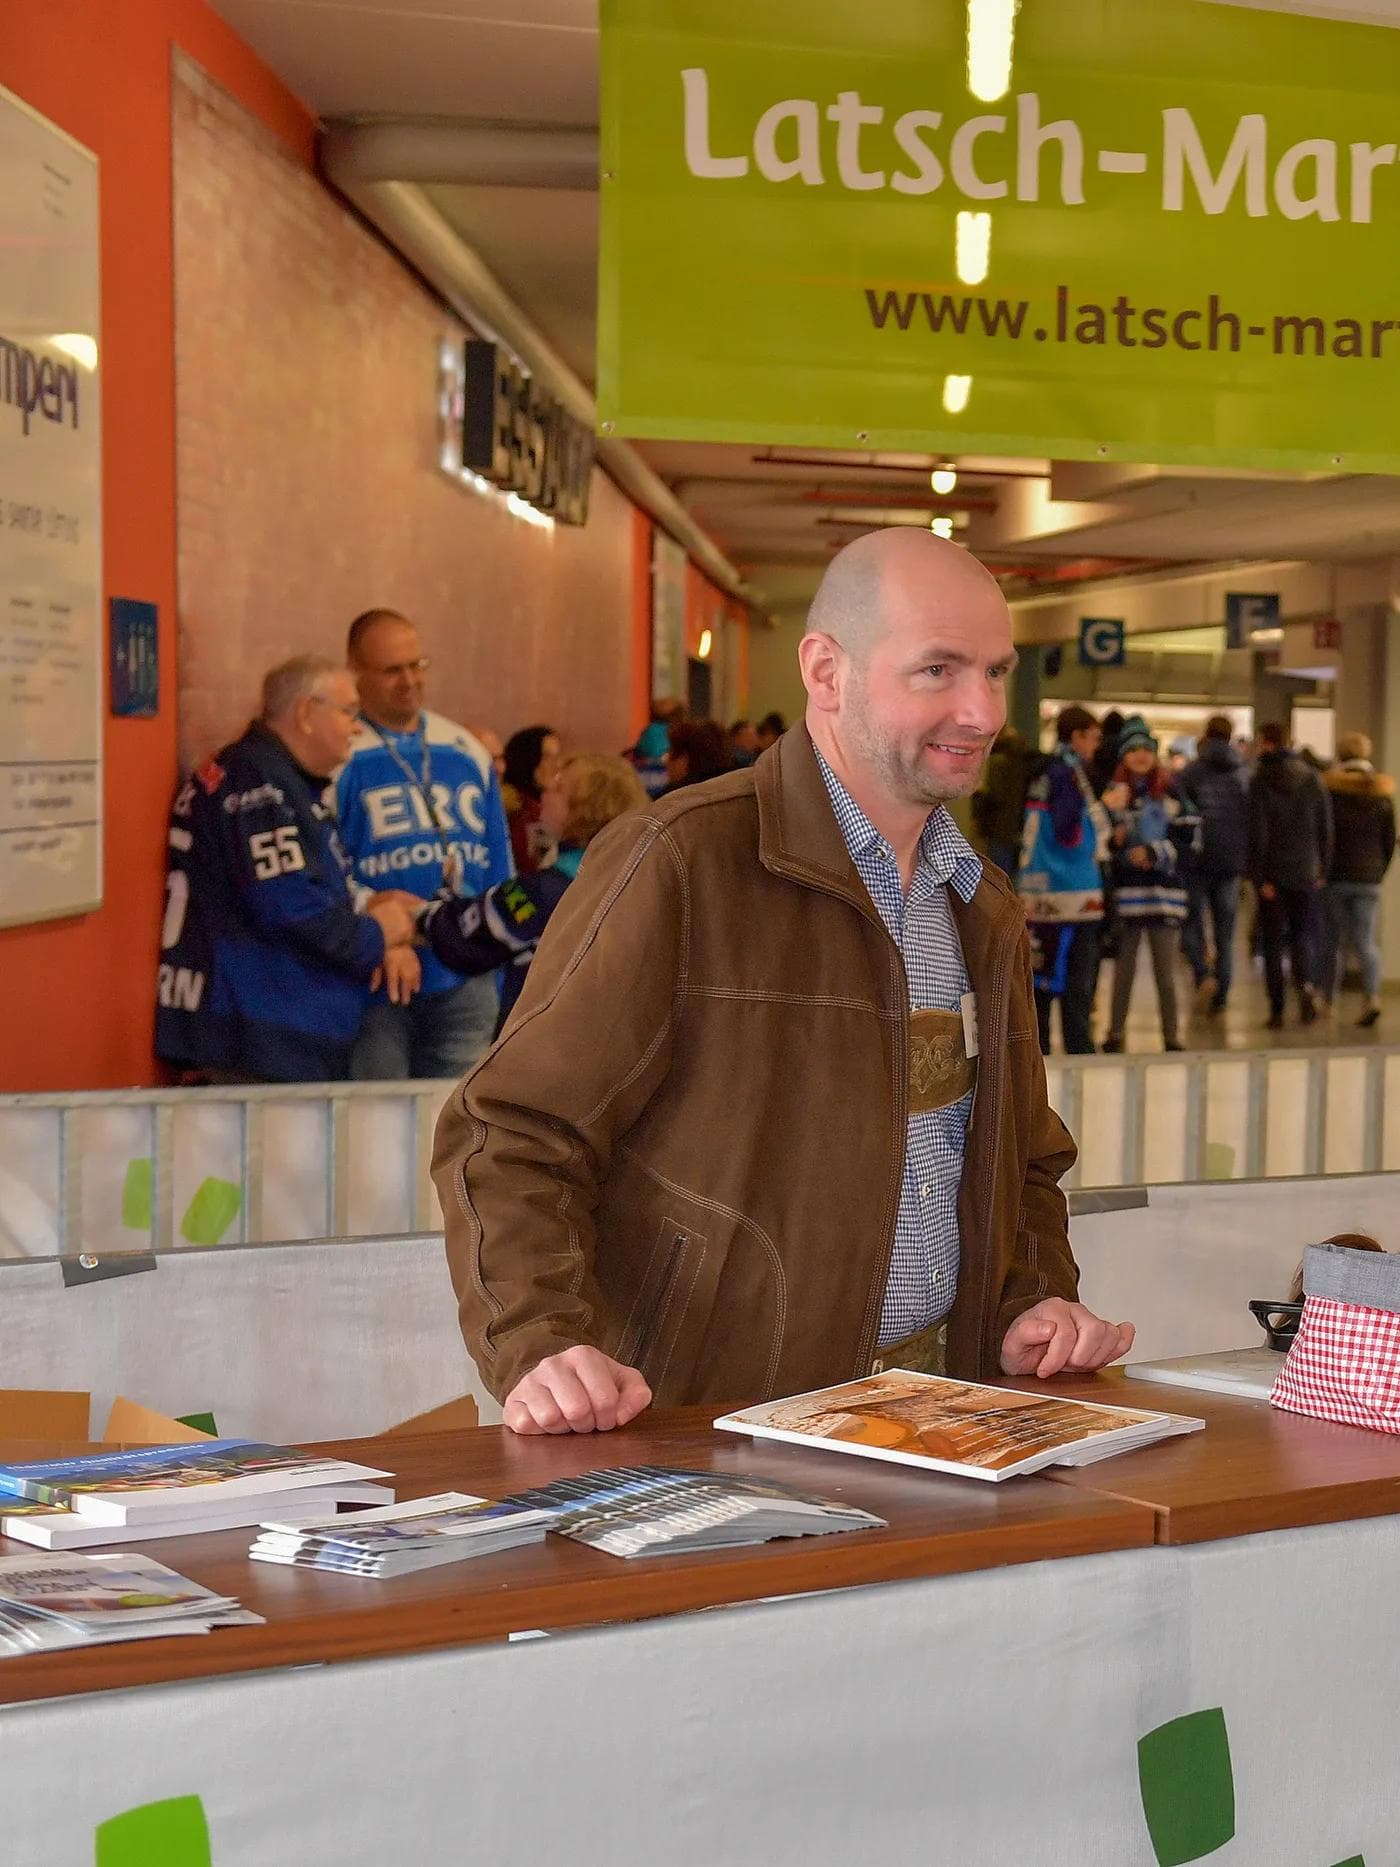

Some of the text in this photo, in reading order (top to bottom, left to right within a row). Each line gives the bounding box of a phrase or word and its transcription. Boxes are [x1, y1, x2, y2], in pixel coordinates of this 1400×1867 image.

[1084, 621, 1120, 662] G
[364, 782, 486, 838] ERC
[250, 825, 306, 881] 55
